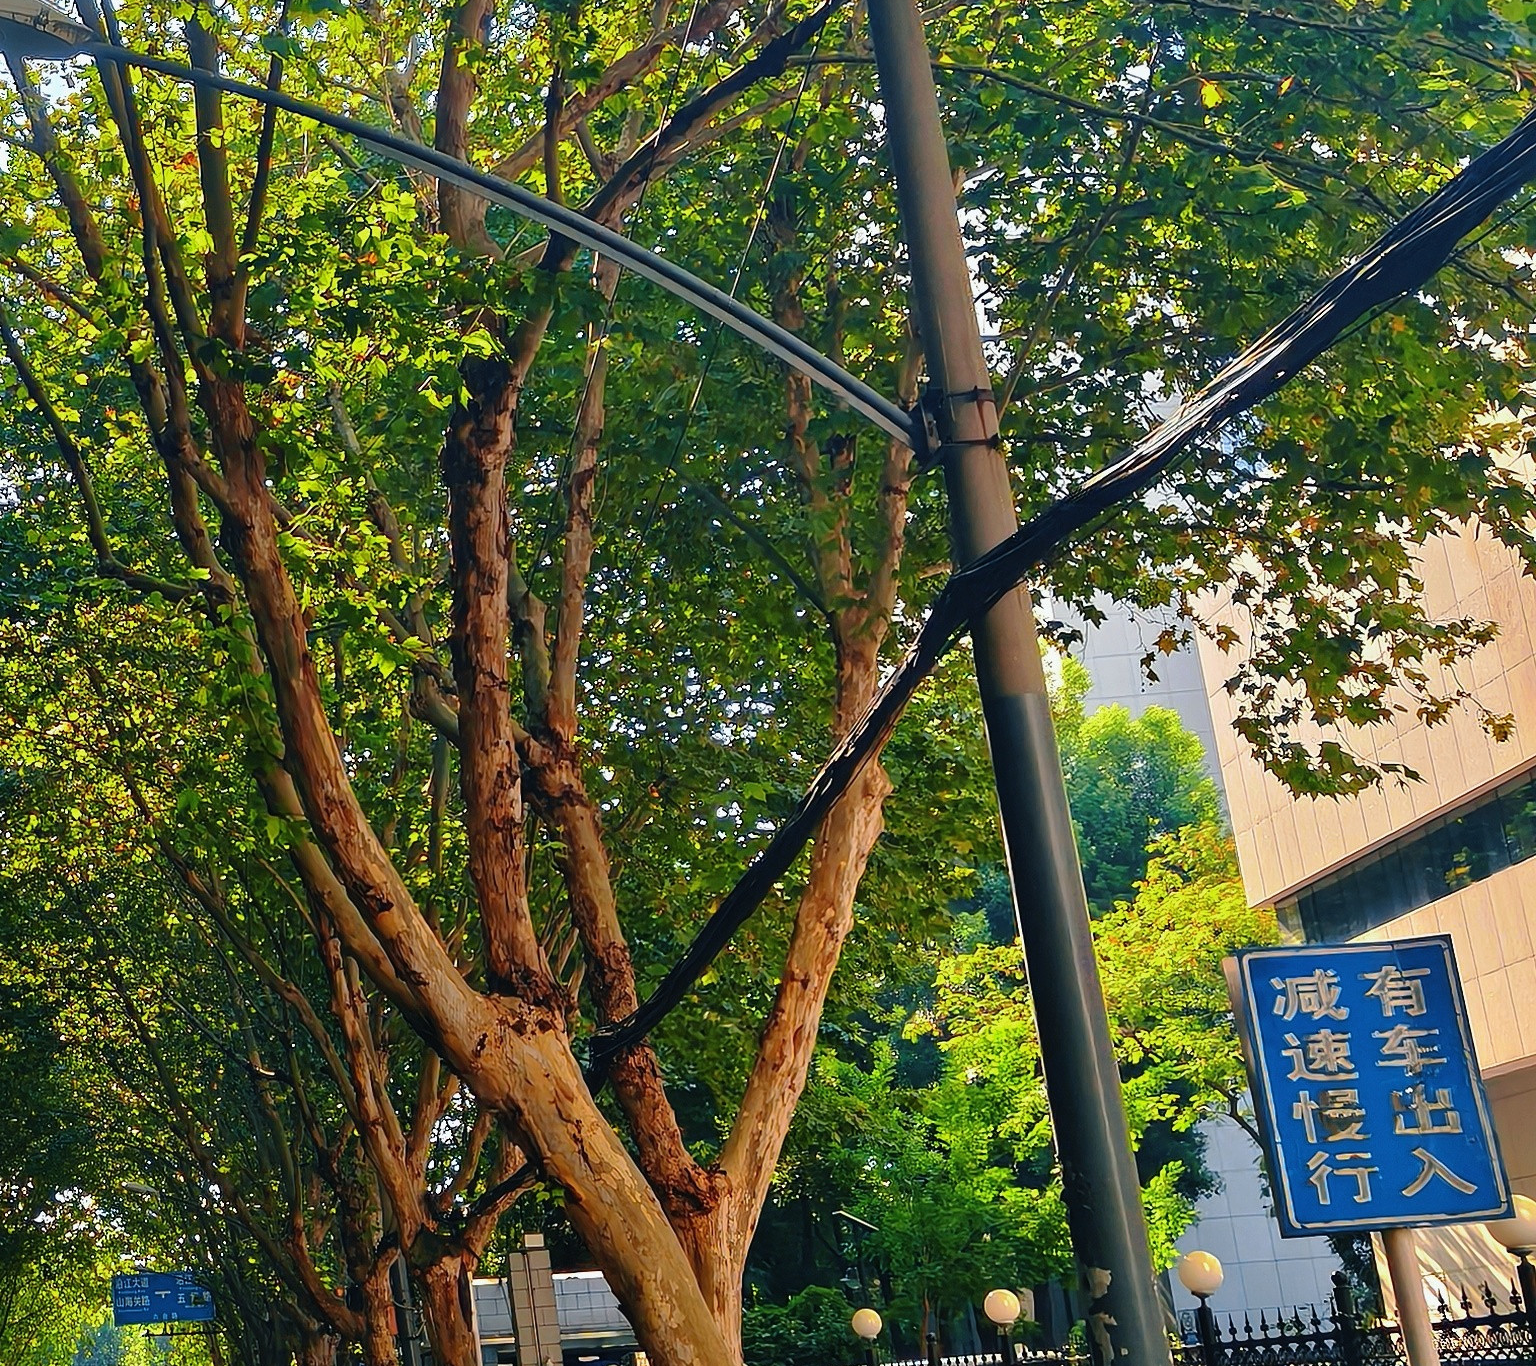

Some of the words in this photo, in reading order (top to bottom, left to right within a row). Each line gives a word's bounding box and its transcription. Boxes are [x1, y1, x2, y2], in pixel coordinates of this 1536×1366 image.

[1270, 968, 1380, 1205] 减速慢行
[1358, 966, 1478, 1196] 有车出入
